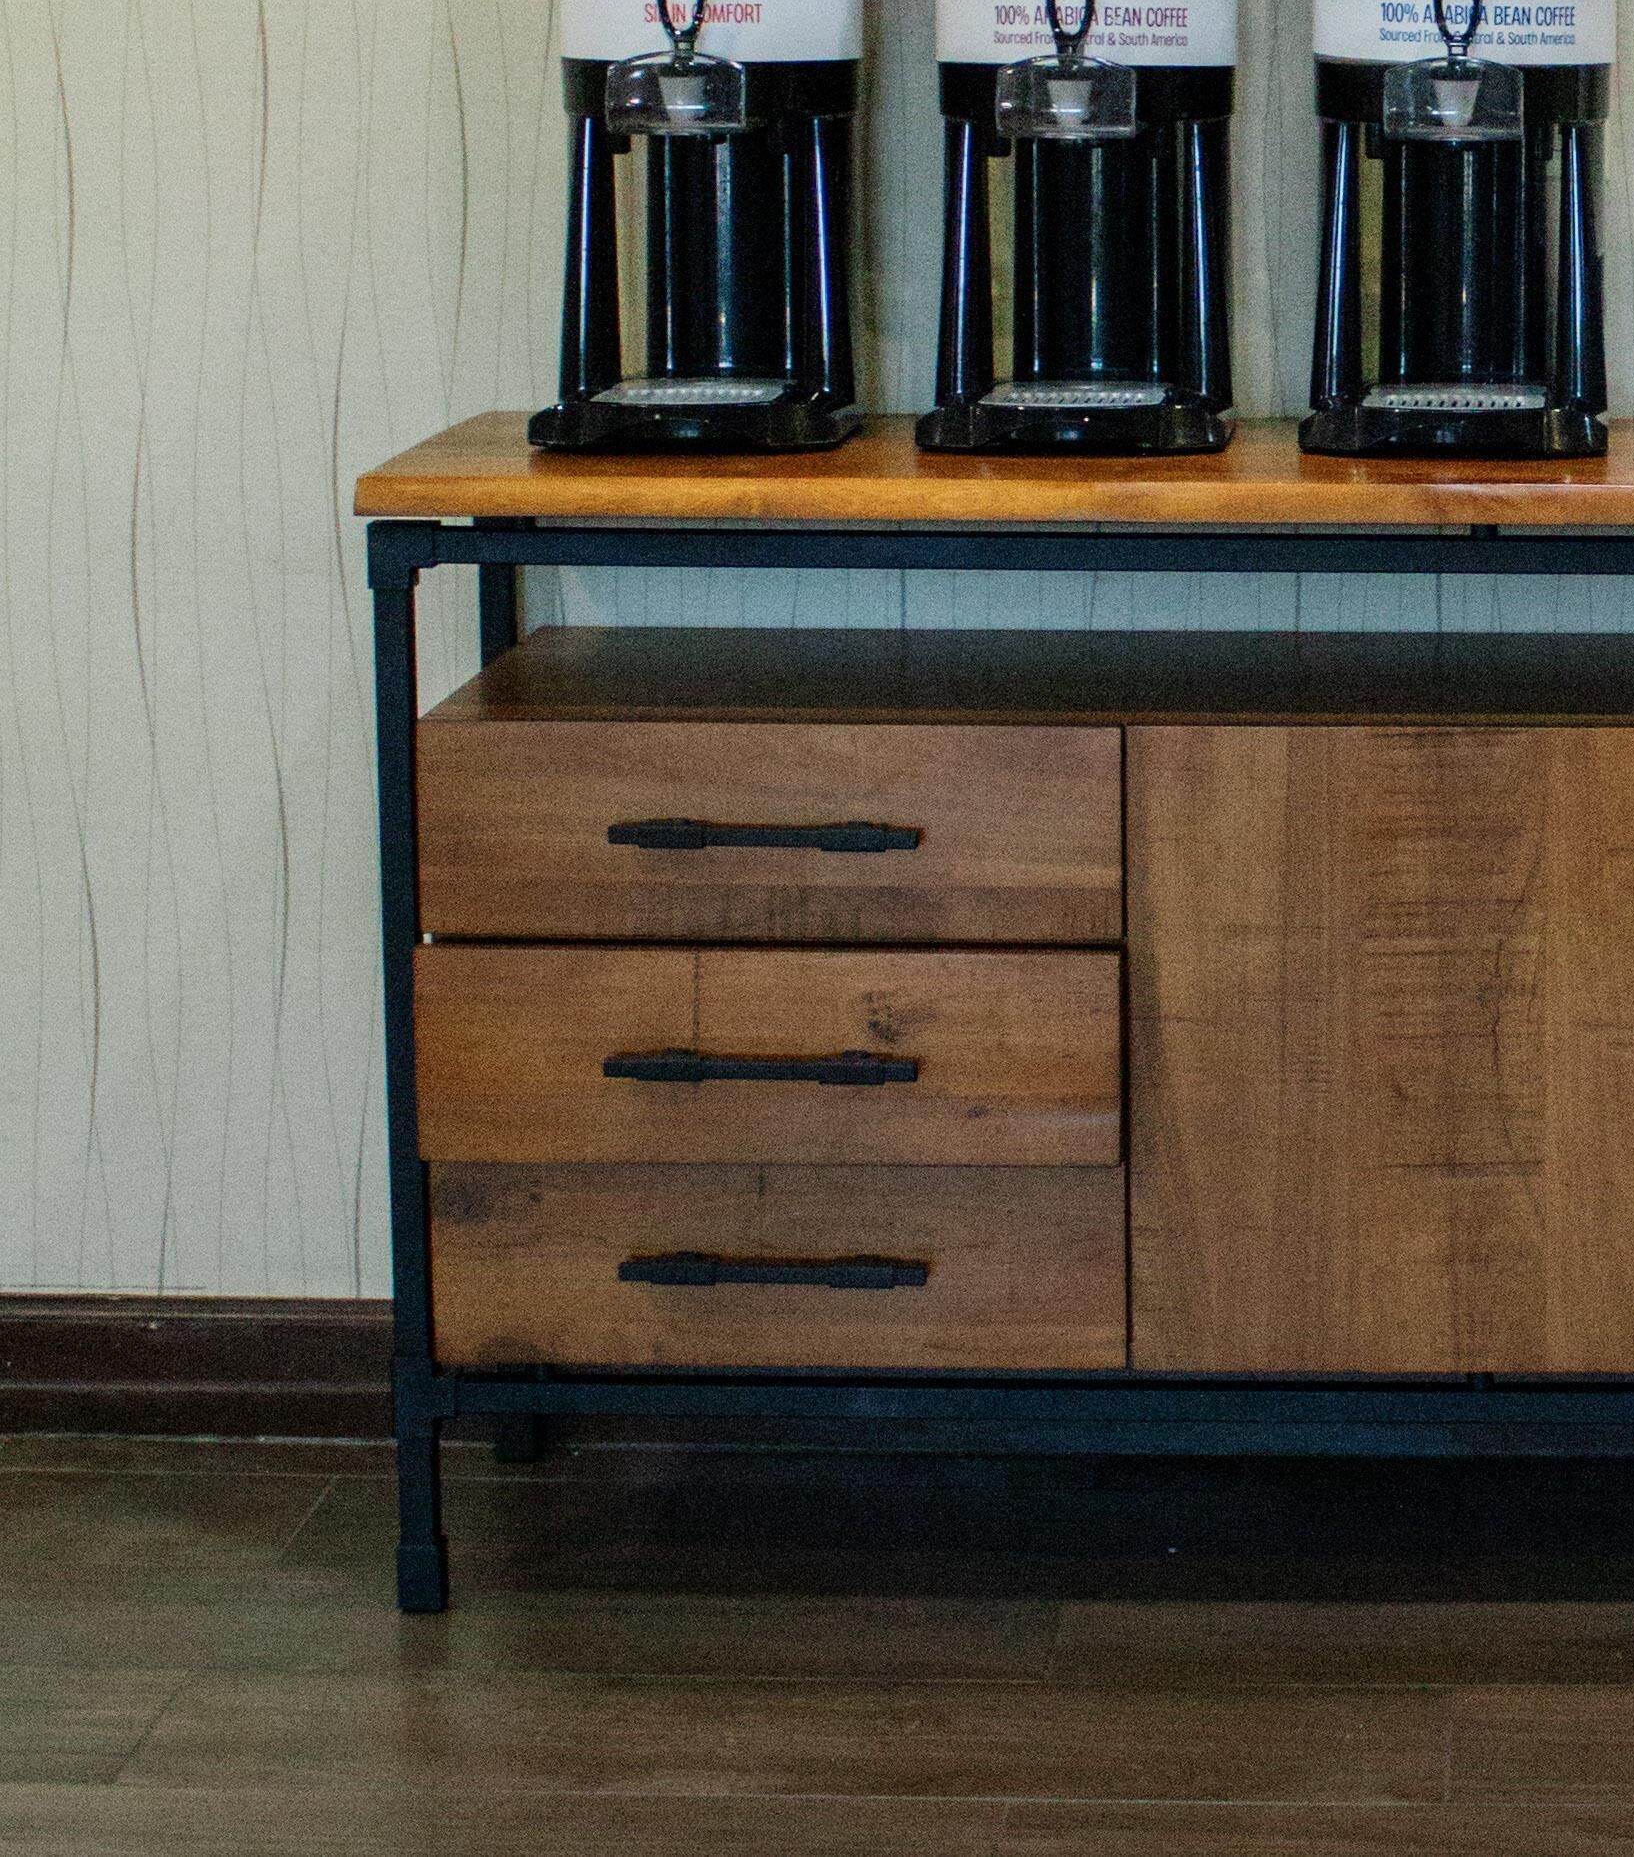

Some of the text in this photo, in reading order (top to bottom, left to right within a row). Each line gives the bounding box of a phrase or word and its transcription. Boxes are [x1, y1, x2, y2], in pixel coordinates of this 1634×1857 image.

[671, 4, 686, 23] IN
[995, 5, 1030, 25] 100%
[1104, 6, 1142, 27] BEAN
[1146, 7, 1188, 28] COFFEE
[1381, 2, 1418, 23] 100%
[1494, 6, 1531, 26] BEAN
[1535, 6, 1576, 27] COFFEE
[994, 31, 1032, 44] Sourced
[1034, 32, 1055, 45] Fro
[1107, 33, 1116, 46] &
[1119, 33, 1149, 46] South
[1151, 33, 1189, 47] America
[1379, 28, 1421, 42] Sourced
[1423, 30, 1443, 43] Fro
[1496, 31, 1505, 45] &
[1508, 31, 1538, 45] South
[1540, 31, 1576, 45] America
